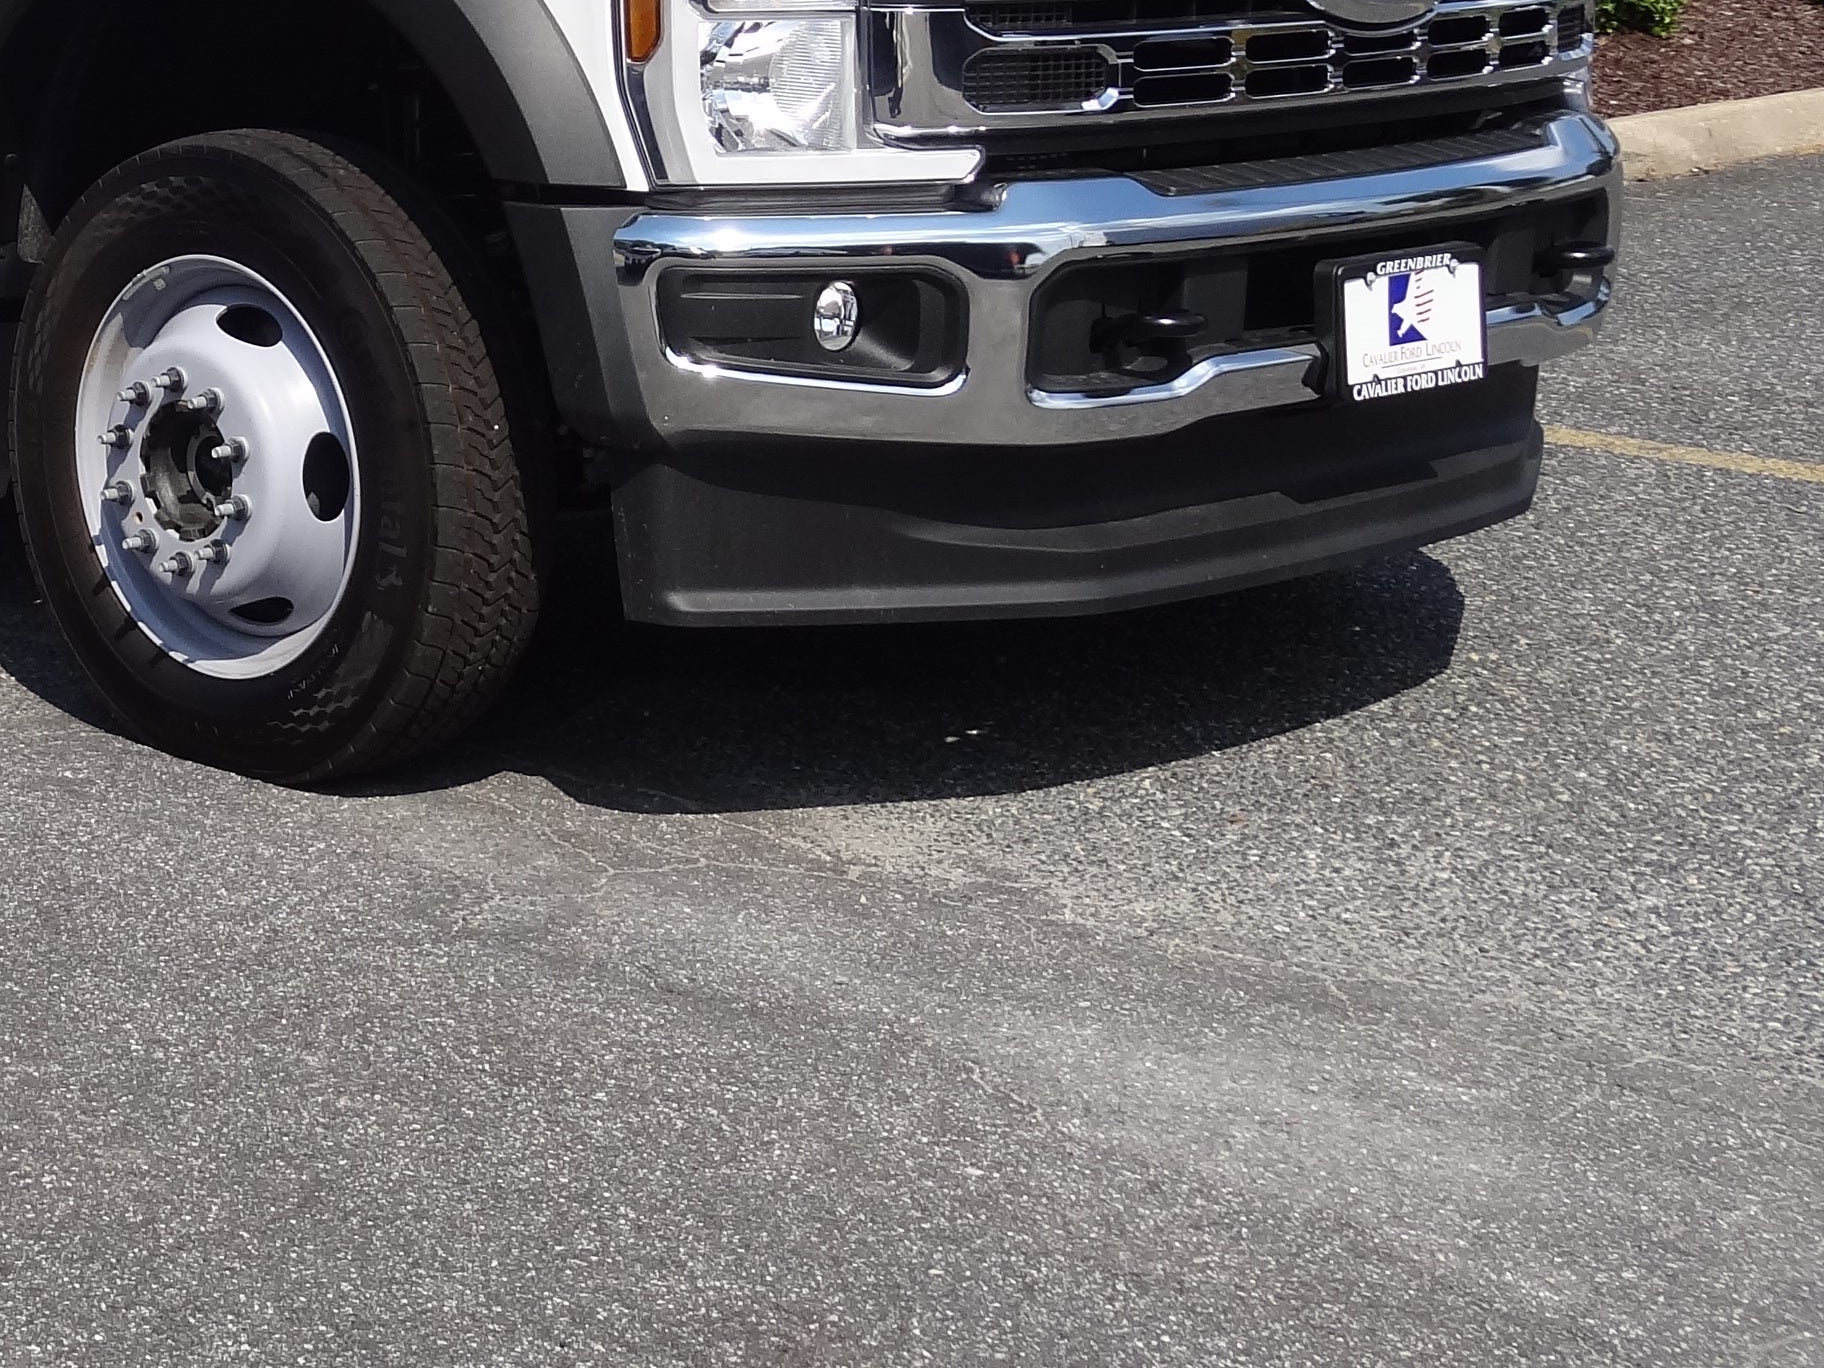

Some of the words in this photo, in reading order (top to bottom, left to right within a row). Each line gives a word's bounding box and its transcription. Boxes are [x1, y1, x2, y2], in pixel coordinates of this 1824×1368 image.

[1376, 253, 1452, 275] GREENBRIER
[1353, 379, 1406, 401] CAVALIER
[1406, 372, 1436, 392] FORD
[1437, 364, 1484, 386] LINCOLN
